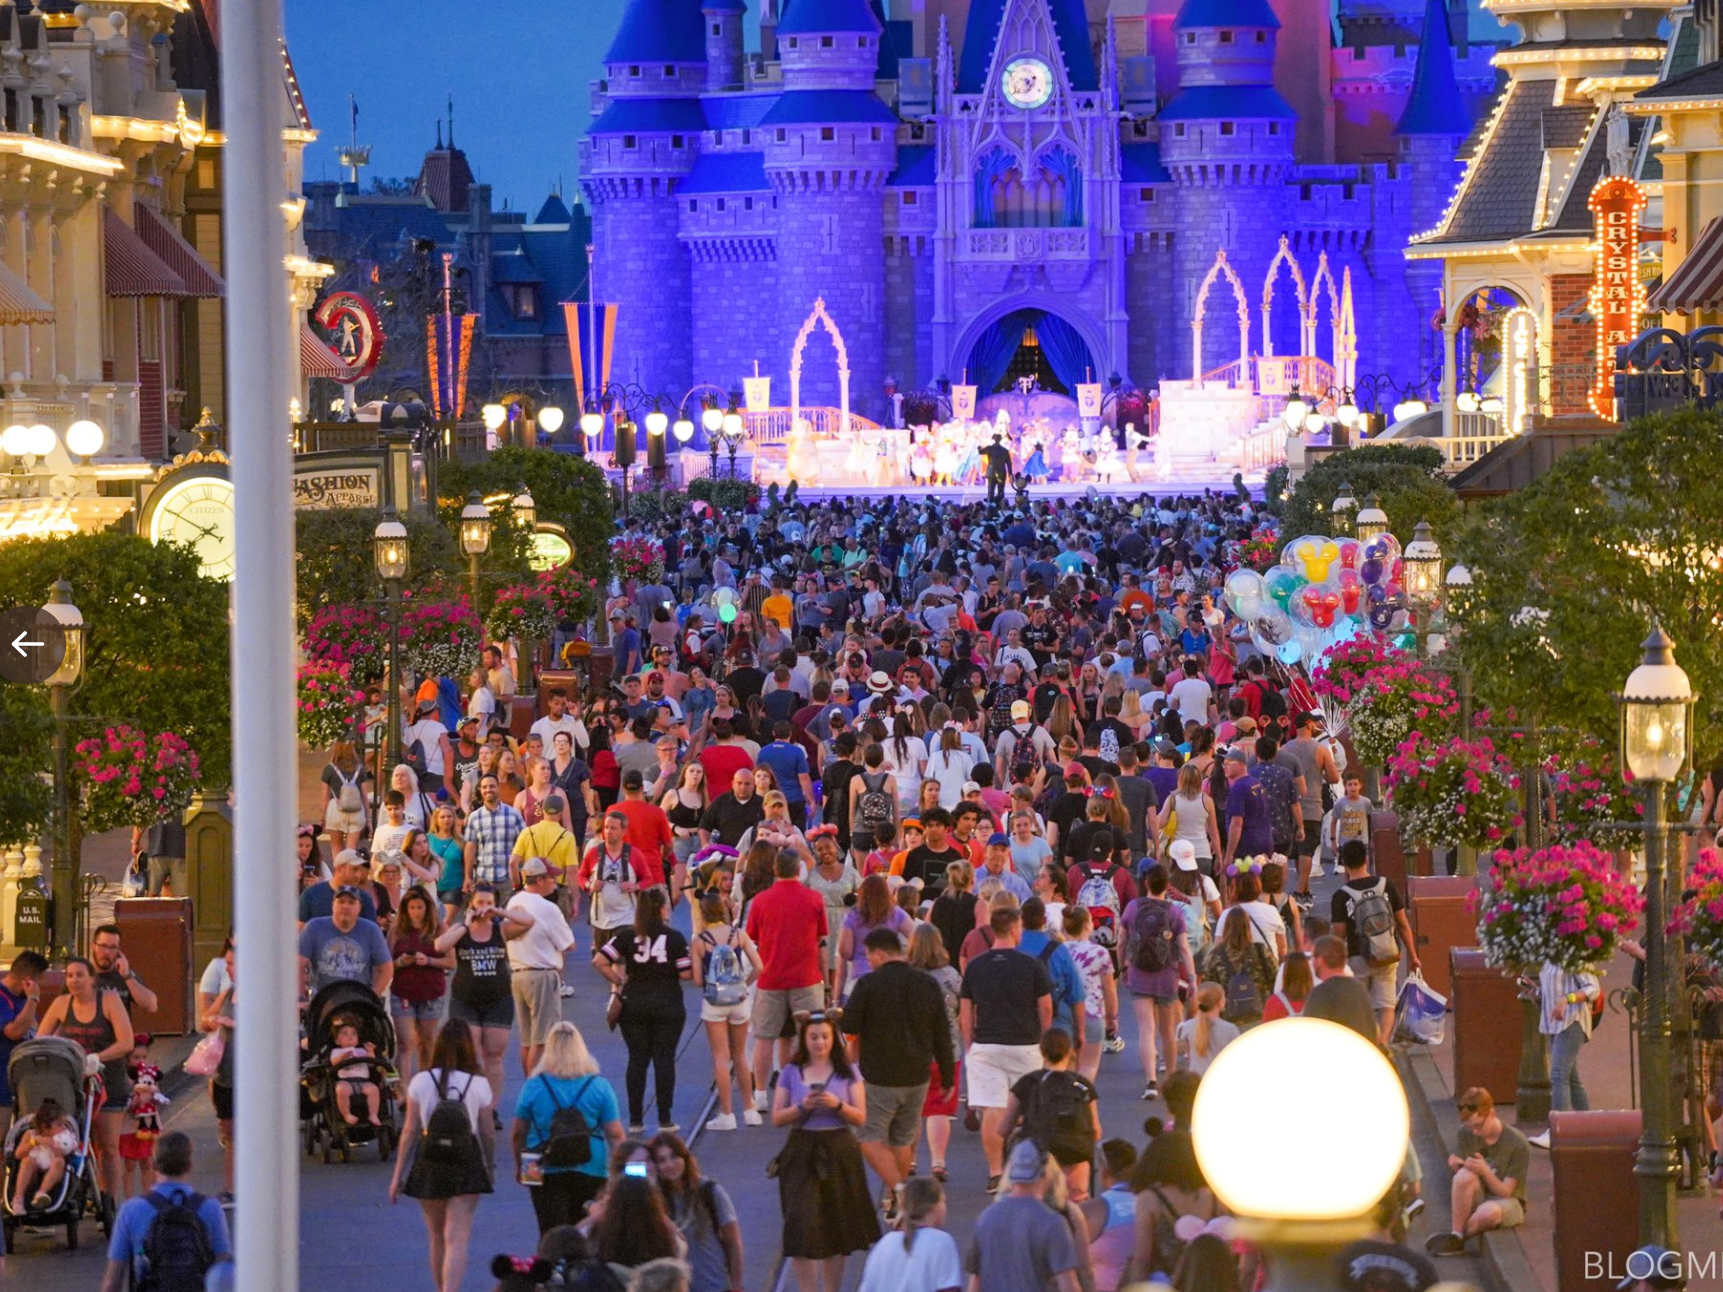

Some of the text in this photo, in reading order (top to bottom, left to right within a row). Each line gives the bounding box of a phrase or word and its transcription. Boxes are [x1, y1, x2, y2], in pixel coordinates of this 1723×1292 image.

[1607, 211, 1628, 314] CRYSTAL
[189, 506, 224, 514] CITIZEN
[23, 906, 40, 914] U.S.
[633, 934, 668, 963] 34
